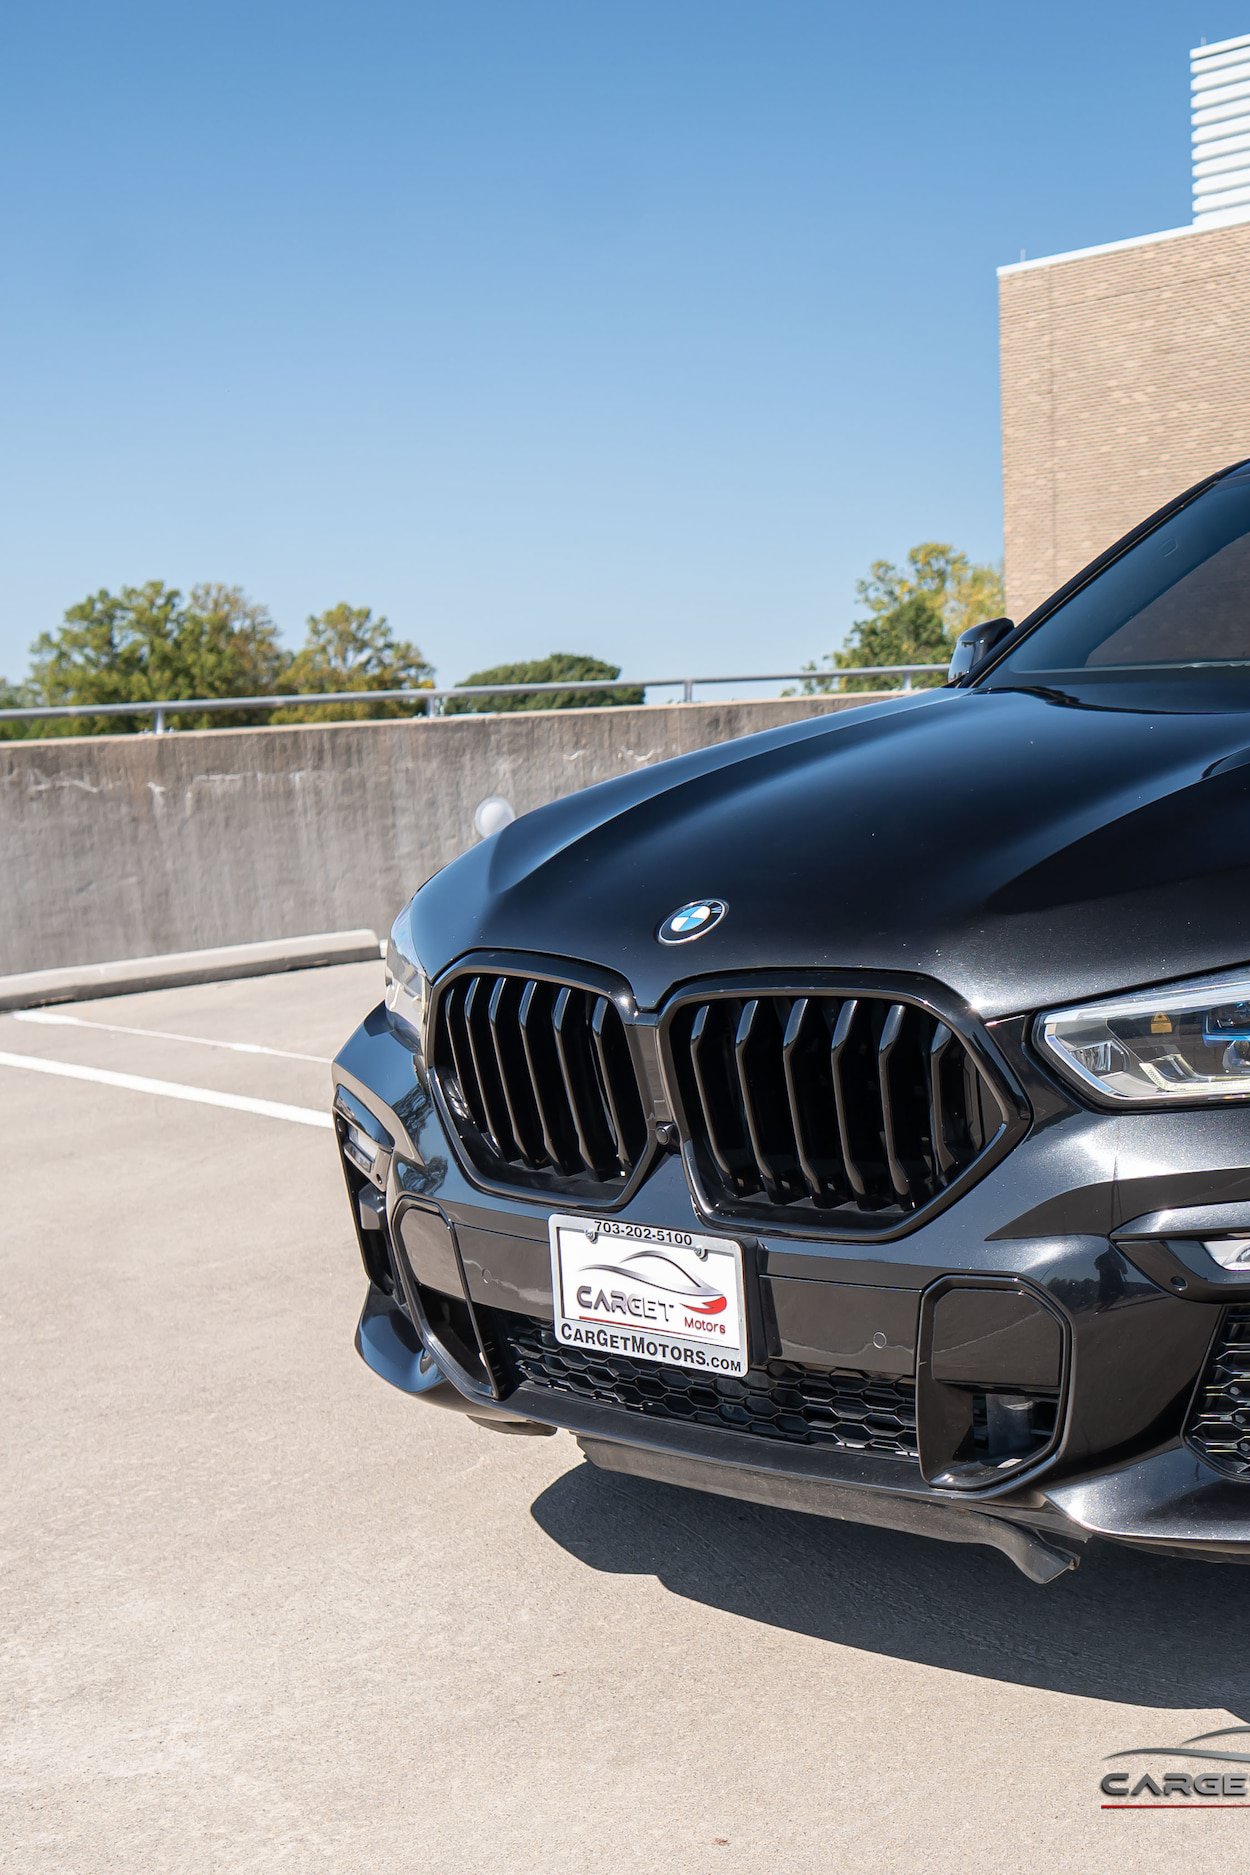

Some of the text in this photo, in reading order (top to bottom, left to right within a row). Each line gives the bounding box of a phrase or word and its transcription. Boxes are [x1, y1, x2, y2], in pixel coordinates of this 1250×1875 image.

[594, 1221, 692, 1246] 703-202-5100
[576, 1285, 726, 1335] CARGET Motors
